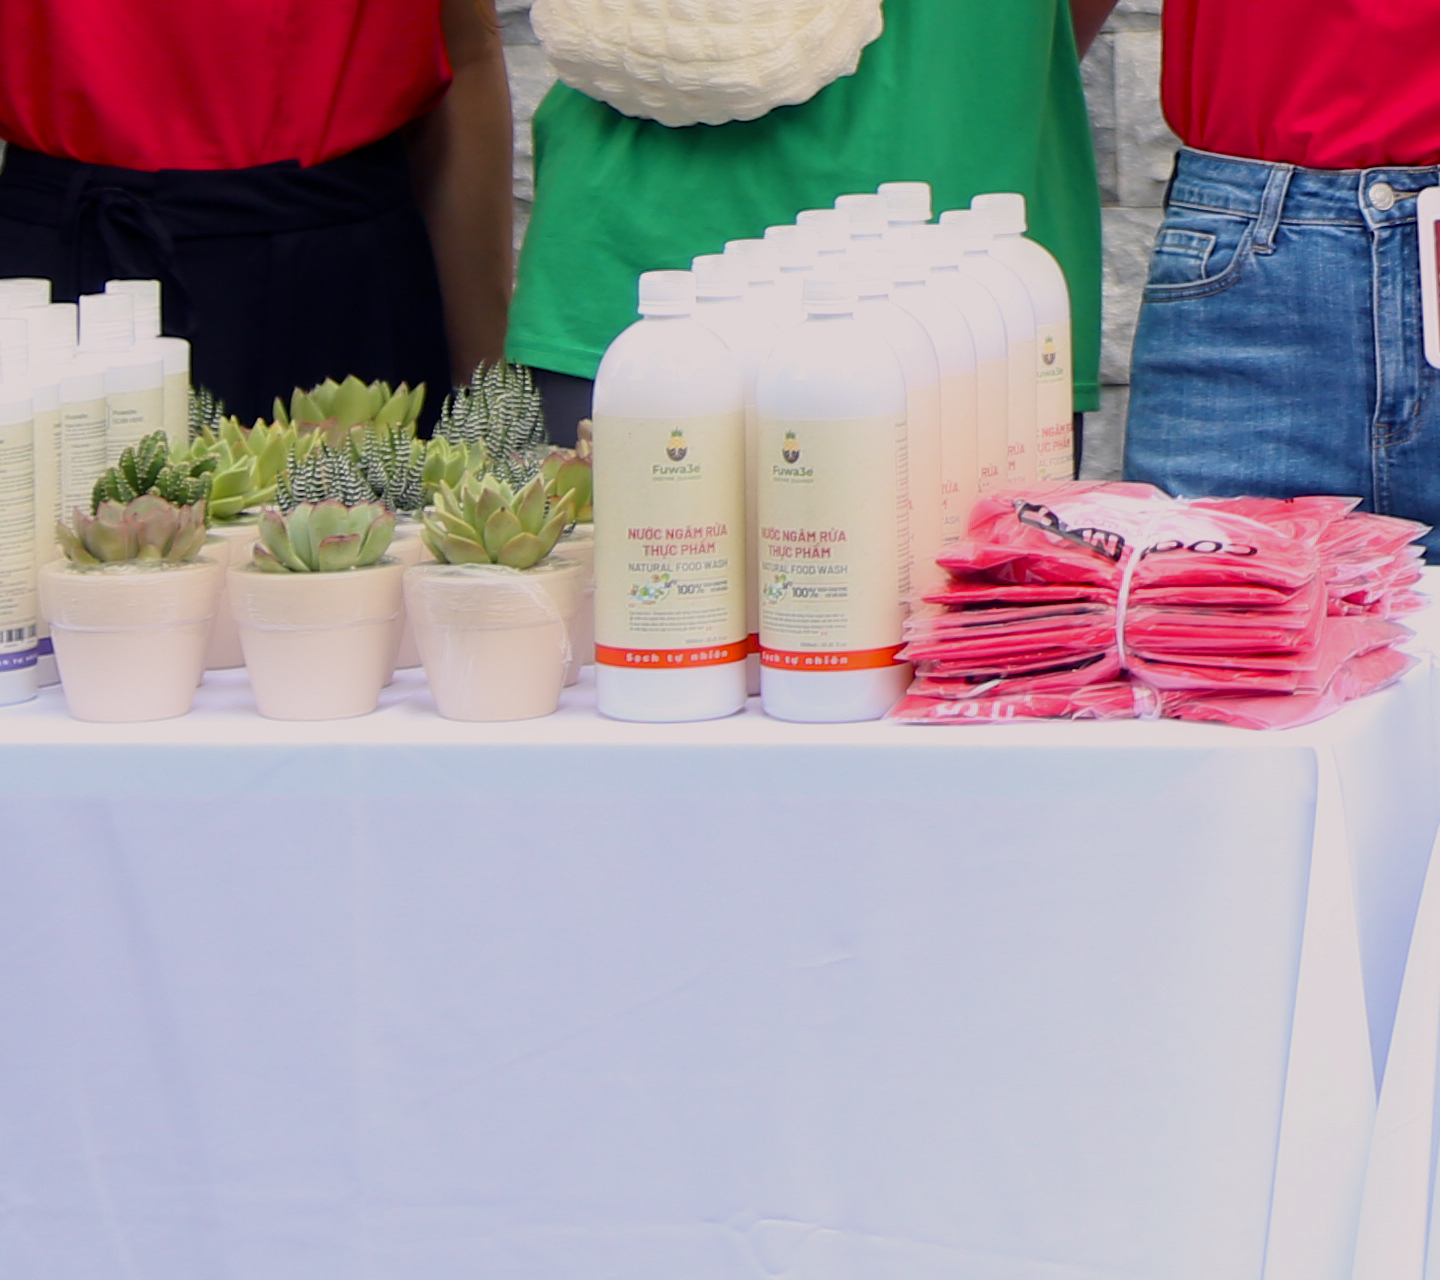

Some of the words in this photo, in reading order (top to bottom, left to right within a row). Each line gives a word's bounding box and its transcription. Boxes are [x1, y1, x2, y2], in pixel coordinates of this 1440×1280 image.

[628, 562, 673, 573] NATURAL
[675, 561, 702, 572] FOOD
[703, 559, 728, 570] WASH
[677, 582, 705, 595] 100%
